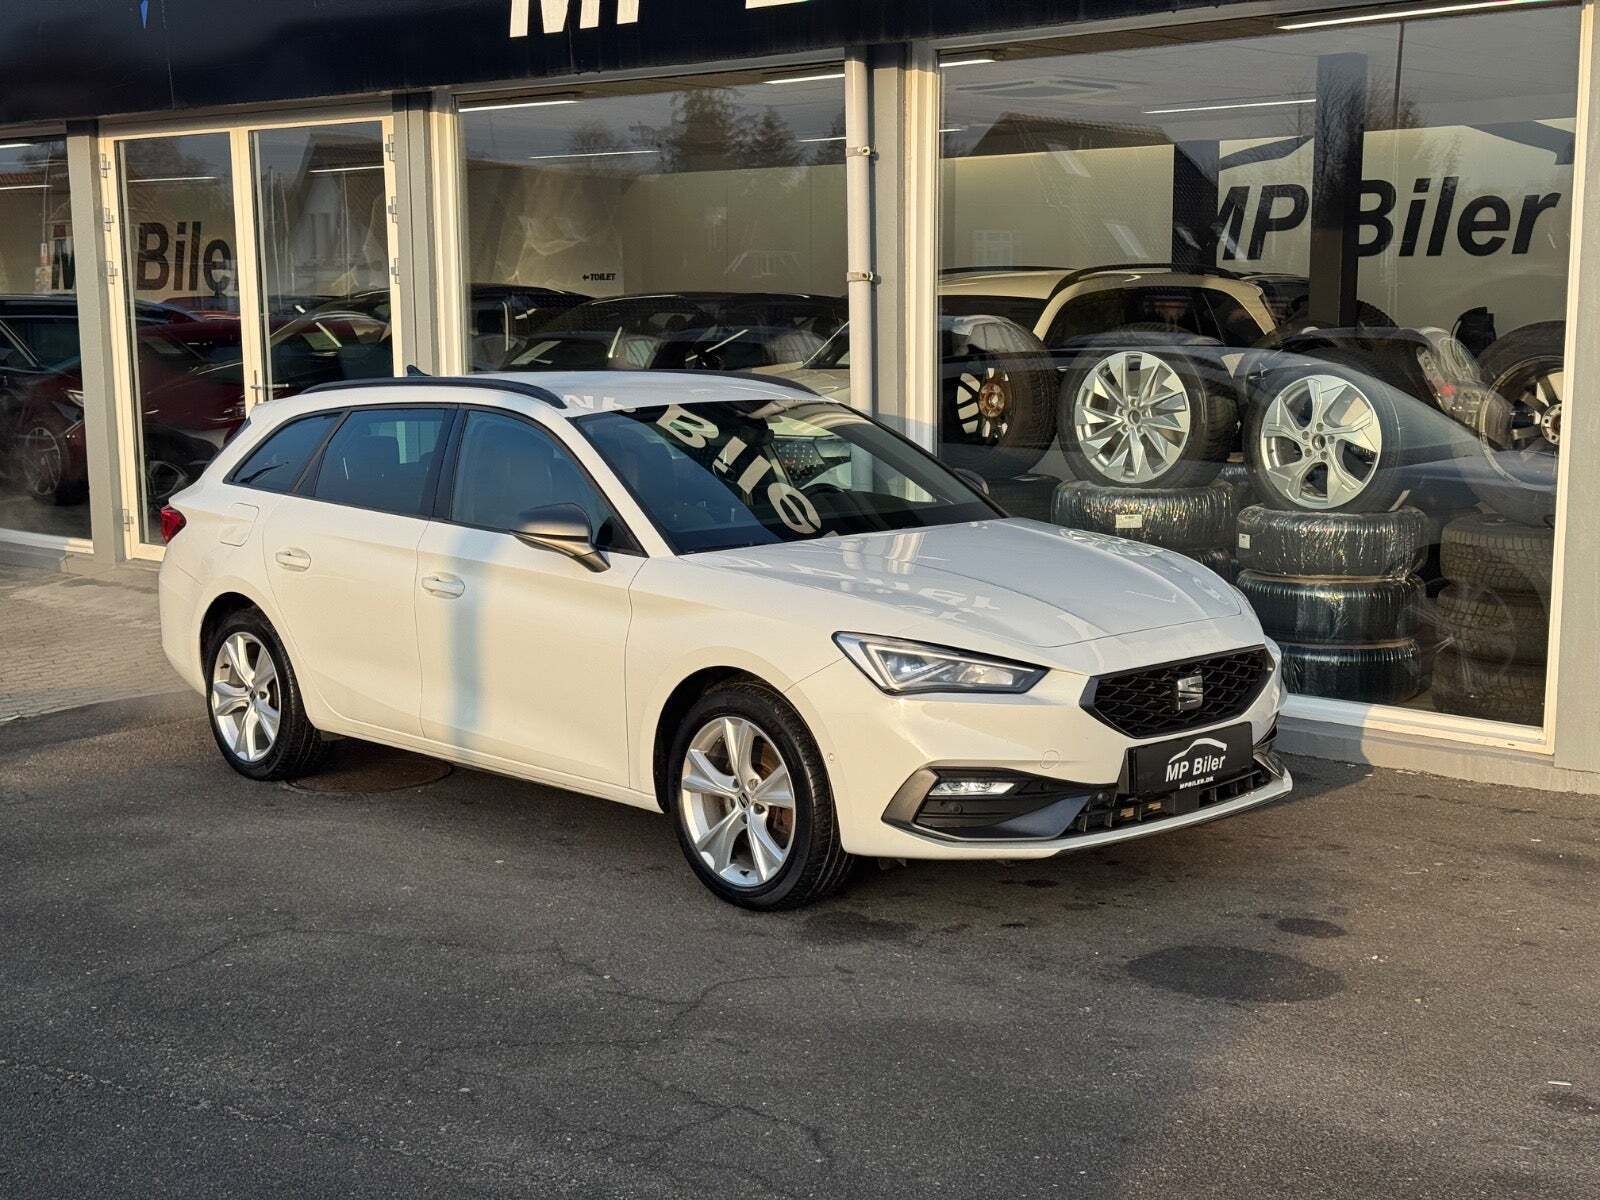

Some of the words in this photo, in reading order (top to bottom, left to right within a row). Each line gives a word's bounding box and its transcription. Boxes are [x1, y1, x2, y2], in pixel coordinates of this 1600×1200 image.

[1357, 176, 1562, 257] Biler
[136, 221, 240, 292] Bile
[590, 272, 617, 281] TOILET
[1165, 761, 1190, 783] MP
[1192, 755, 1226, 776] Biler
[1179, 776, 1214, 790] MPBILER.DK
